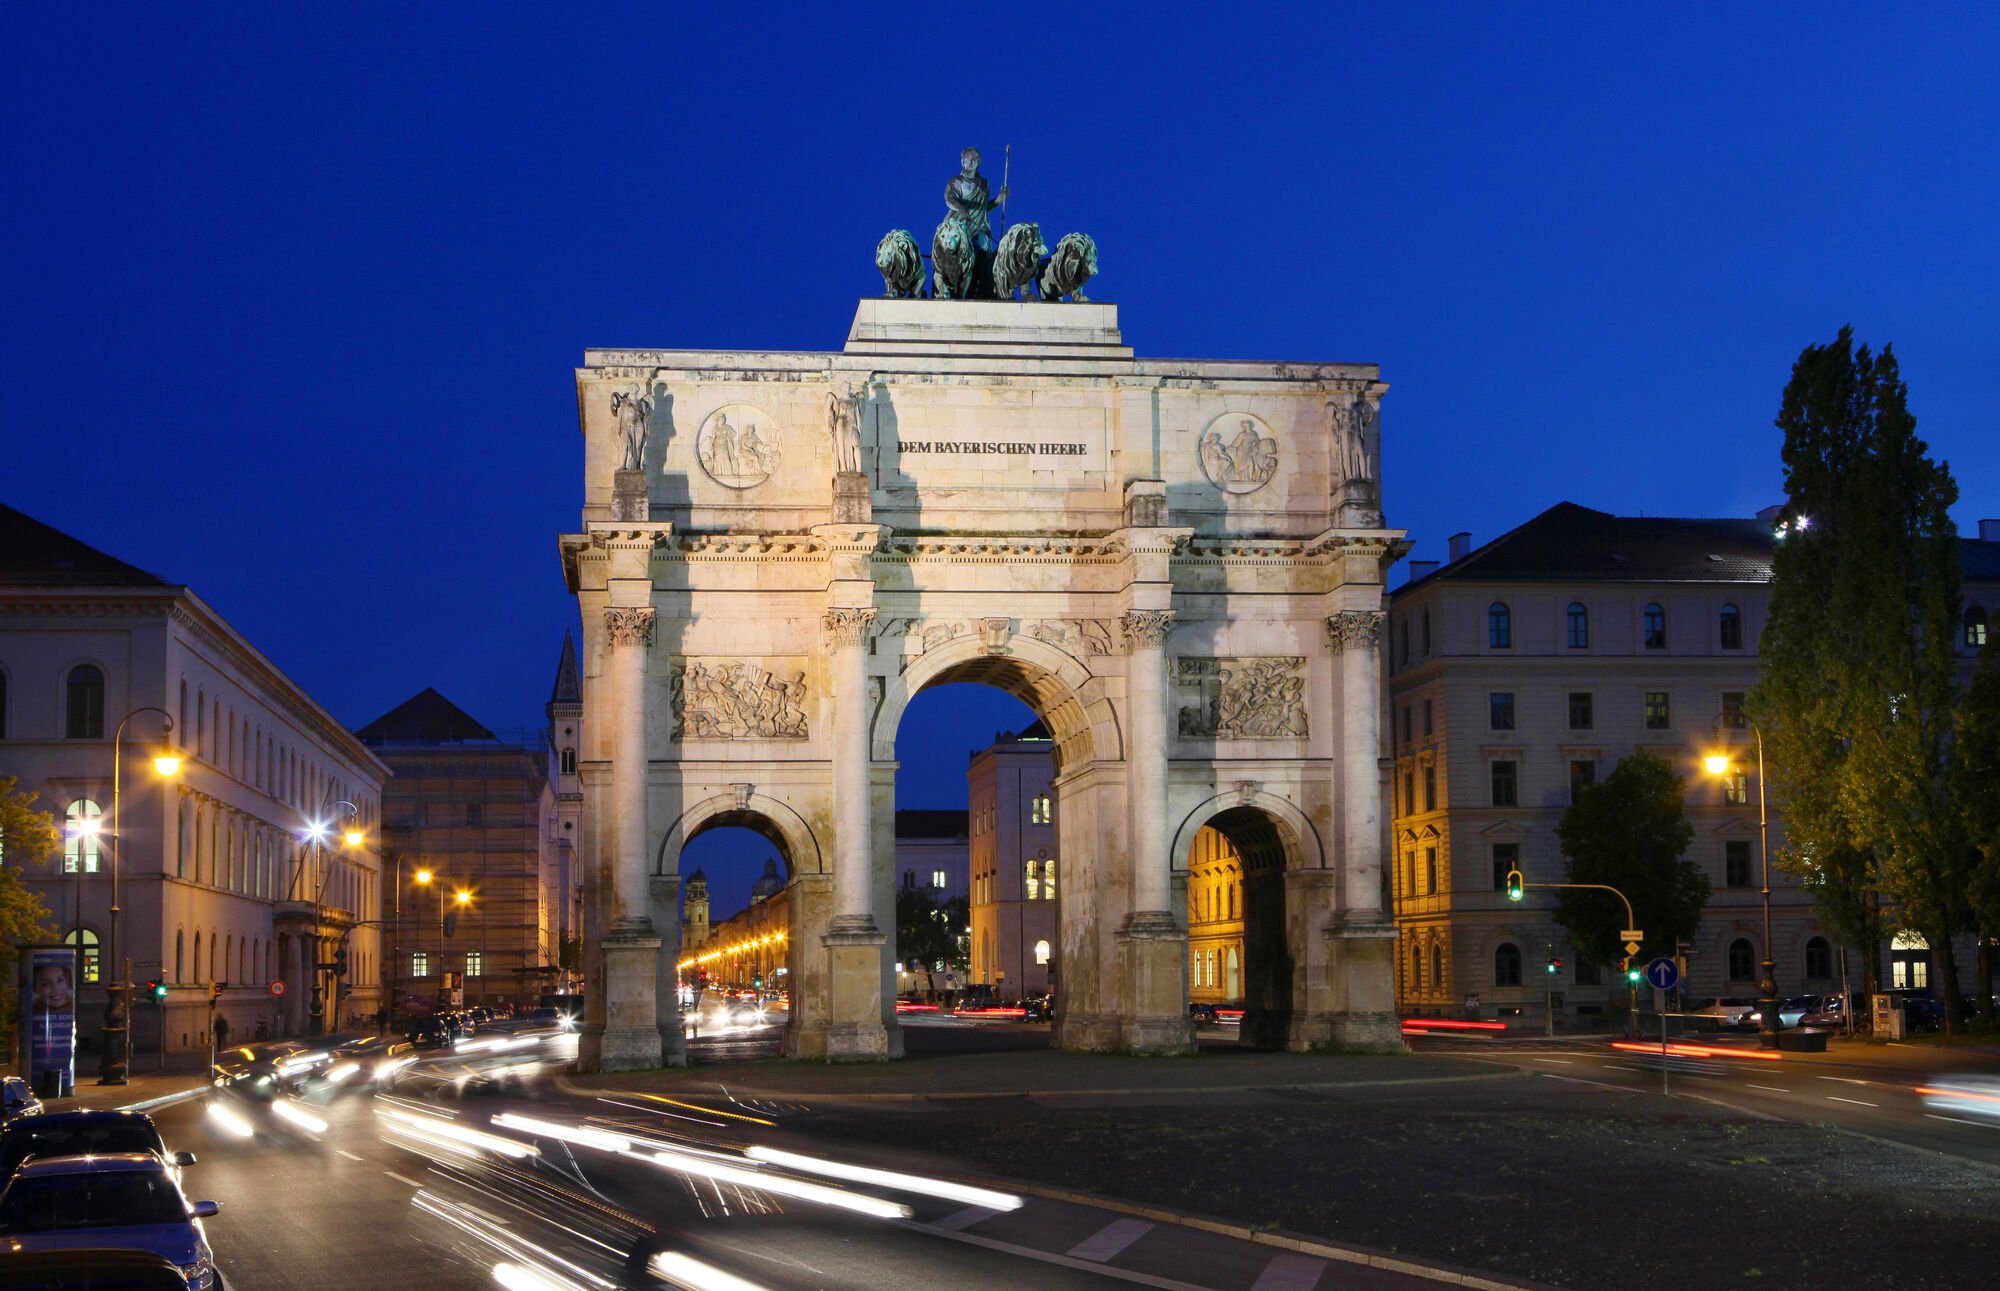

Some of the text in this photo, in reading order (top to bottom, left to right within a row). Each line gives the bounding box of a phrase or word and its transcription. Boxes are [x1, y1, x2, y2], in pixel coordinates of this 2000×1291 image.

[897, 441, 1087, 455] DEM BAYERISCHEN HEERE
